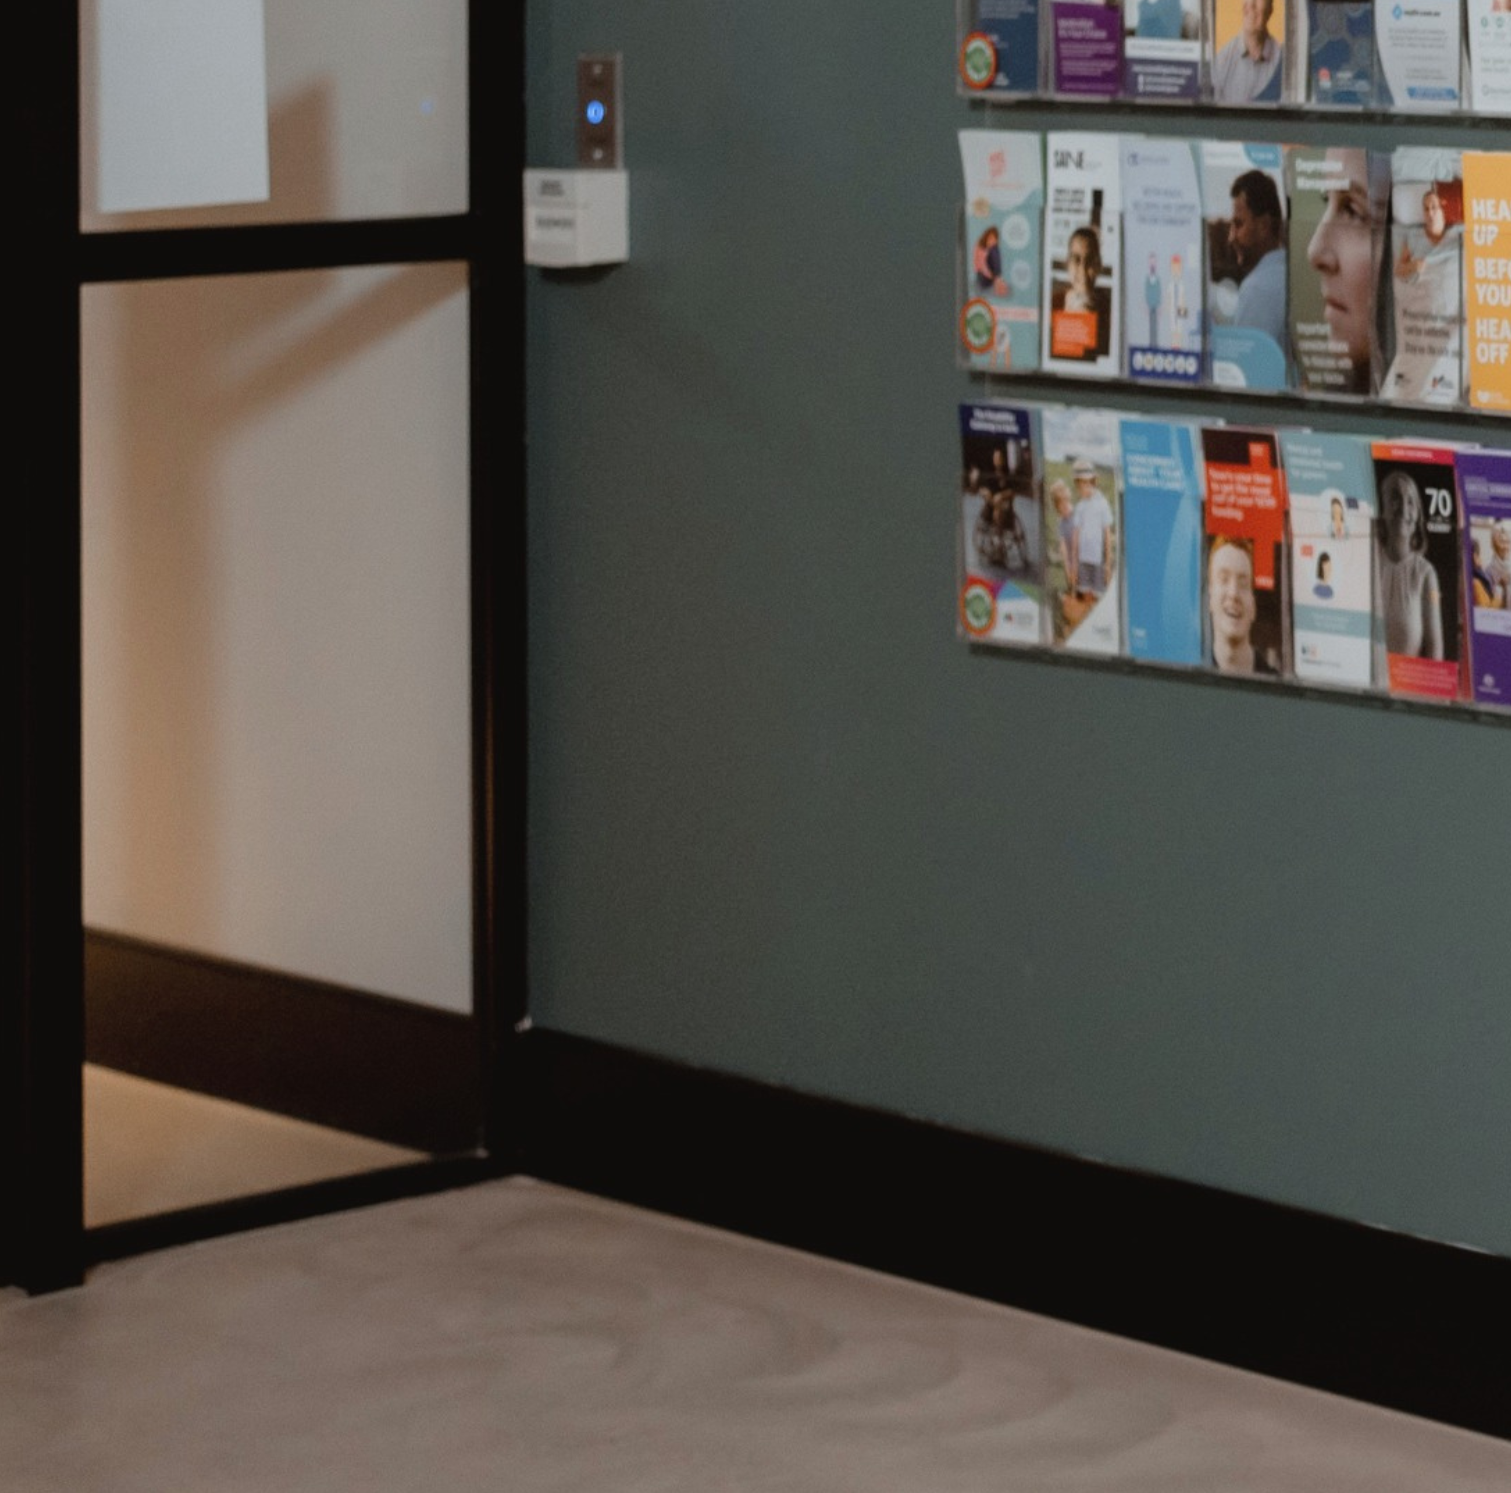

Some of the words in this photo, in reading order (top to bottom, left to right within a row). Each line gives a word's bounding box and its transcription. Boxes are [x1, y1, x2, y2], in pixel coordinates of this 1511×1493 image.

[1473, 225, 1498, 246] UP
[1477, 342, 1509, 364] OFF
[1425, 486, 1452, 517] 70
